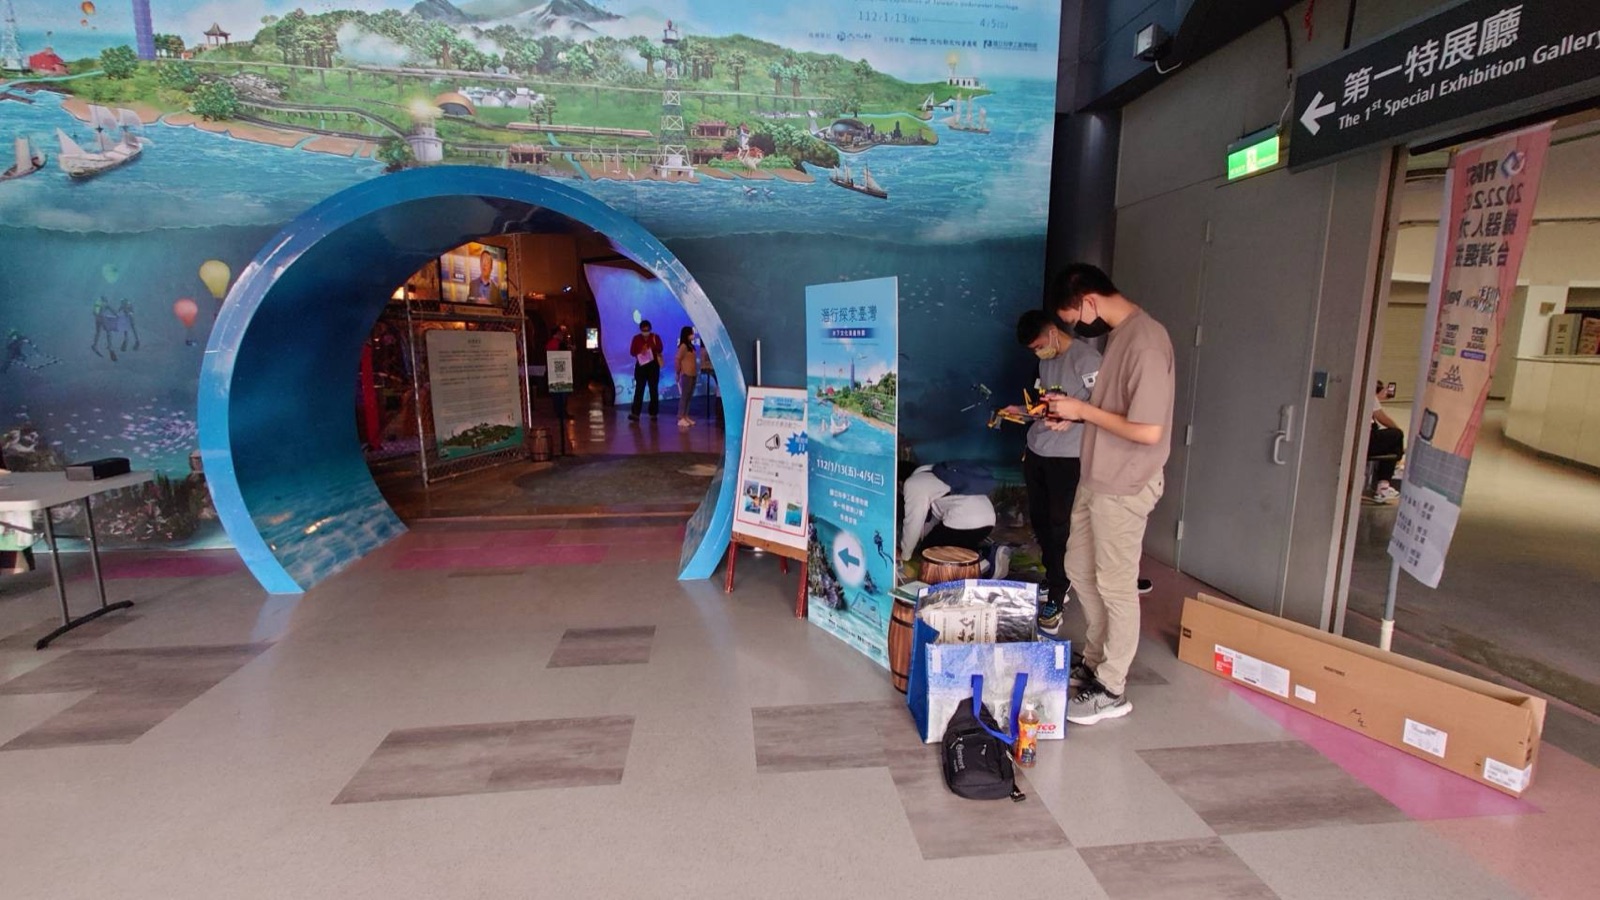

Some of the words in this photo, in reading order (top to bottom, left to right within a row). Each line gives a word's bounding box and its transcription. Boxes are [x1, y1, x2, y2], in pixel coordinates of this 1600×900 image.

[1342, 4, 1524, 107] 第一特展廳
[1339, 113, 1360, 130] The
[1365, 98, 1382, 121] 1st
[1383, 83, 1436, 117] Special
[1439, 56, 1527, 97] Exhibition
[821, 305, 877, 322] 潛行探索臺灣
